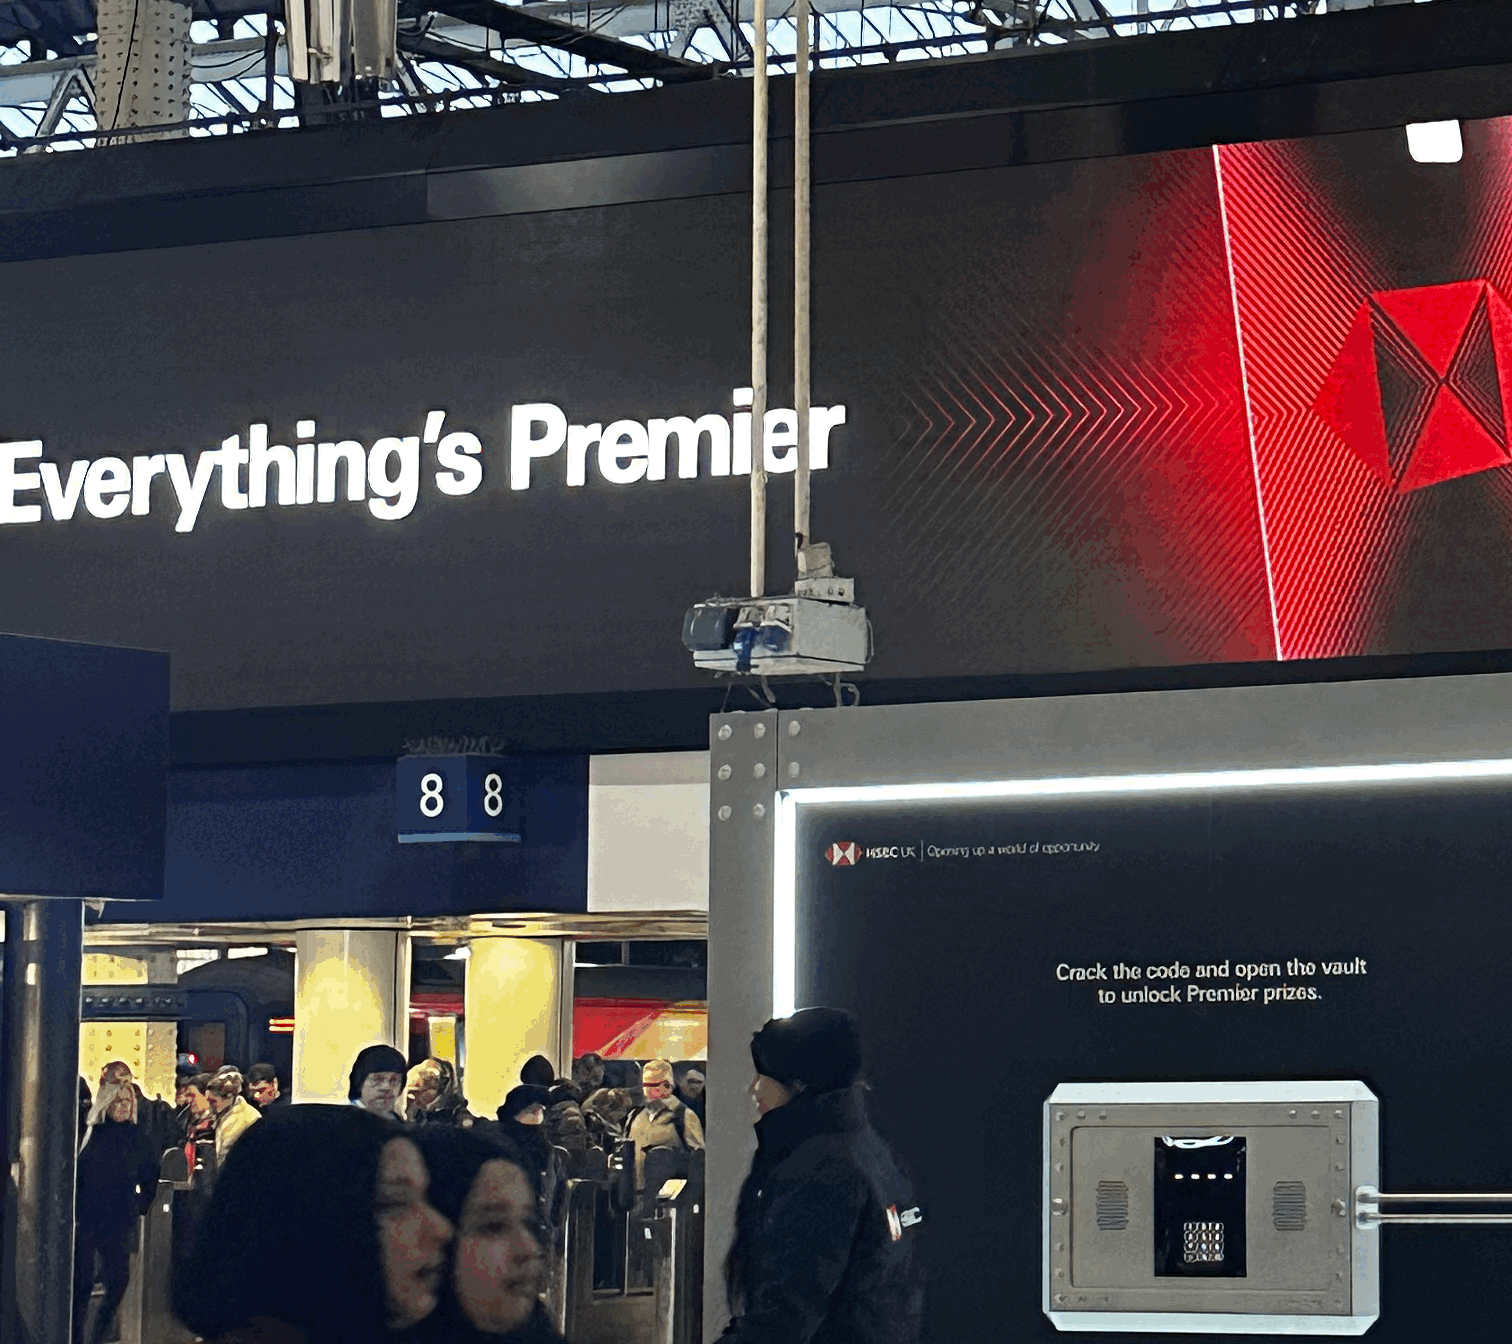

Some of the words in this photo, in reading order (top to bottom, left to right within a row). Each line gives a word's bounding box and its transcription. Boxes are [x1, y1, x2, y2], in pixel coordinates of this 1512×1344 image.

[0, 411, 482, 532] Everything's
[511, 387, 845, 491] Premier
[420, 773, 444, 817] 8
[484, 773, 502, 817] 8
[866, 846, 898, 859] HSBC
[1056, 962, 1108, 981] Crack
[1113, 961, 1142, 980] the
[1146, 961, 1191, 980] code
[1195, 960, 1230, 979] and
[1235, 962, 1281, 981] open
[1287, 958, 1316, 976] the
[1321, 957, 1368, 976] vault
[1098, 986, 1116, 1004] to
[1121, 985, 1182, 1003] unlock
[1187, 983, 1259, 1002] Premier
[1264, 983, 1323, 1004] prizes.
